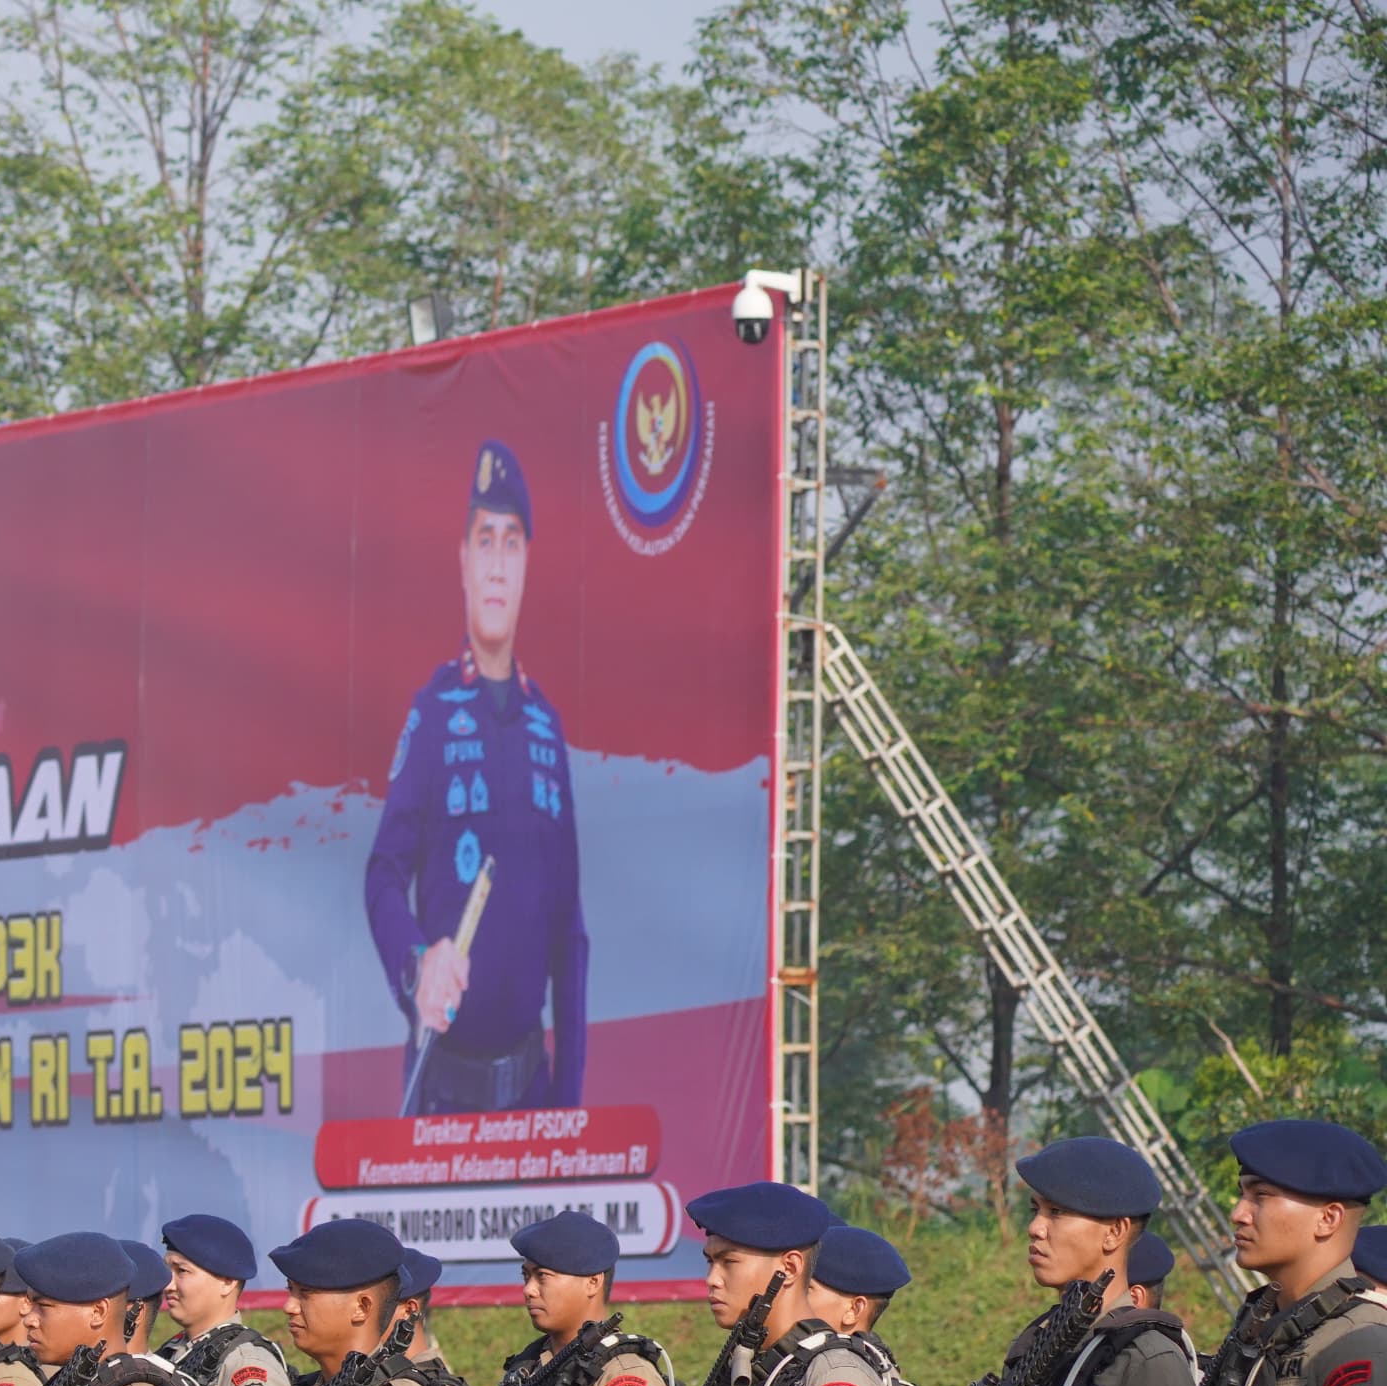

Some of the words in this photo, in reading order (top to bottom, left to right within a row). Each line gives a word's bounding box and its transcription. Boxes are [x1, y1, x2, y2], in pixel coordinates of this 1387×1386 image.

[30, 1036, 70, 1125] RI
[86, 1030, 163, 1122] T.A.
[179, 1020, 293, 1118] 2024
[413, 1117, 473, 1147] Direktur
[474, 1112, 531, 1144] Jendral
[532, 1109, 589, 1140] PSDKP
[358, 1156, 450, 1186] Kementerian
[450, 1152, 517, 1182] Kelautan
[518, 1151, 549, 1179] dan
[549, 1148, 627, 1177] Perikanan
[629, 1144, 648, 1174] RI
[400, 1207, 476, 1242] NUGROHO
[605, 1201, 644, 1235] M.M.
